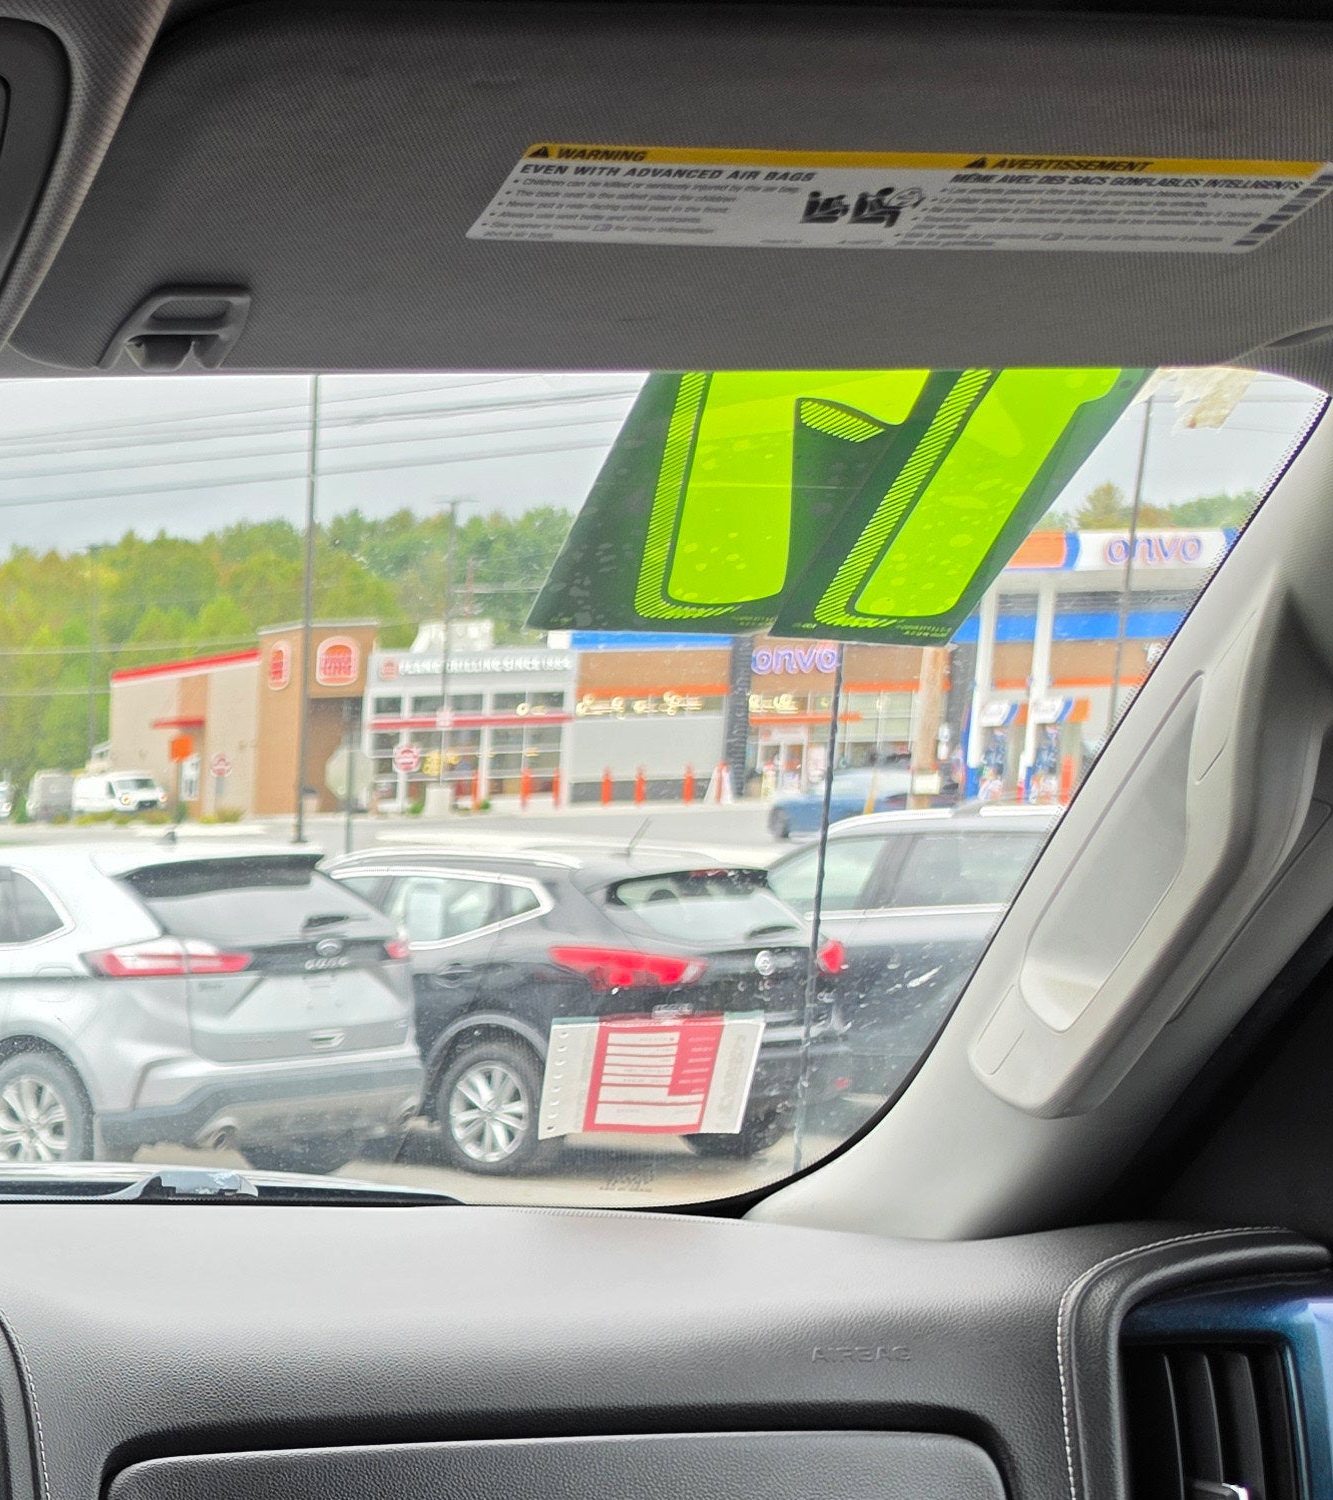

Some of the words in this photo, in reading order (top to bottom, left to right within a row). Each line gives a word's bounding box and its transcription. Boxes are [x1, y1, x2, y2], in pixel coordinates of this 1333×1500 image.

[557, 148, 647, 161] WARNING
[520, 164, 568, 174] EVEN
[573, 166, 621, 176] WITH
[623, 168, 723, 179] ADVANCED
[726, 170, 760, 180] AIR
[764, 172, 816, 181] BAGS
[991, 158, 1154, 172] AVERTISSEMENT
[1001, 175, 1035, 184] AVEC
[1038, 176, 1068, 185] DES
[1069, 176, 1107, 186] SACS
[1105, 535, 1203, 565] onvo
[751, 645, 838, 675] onvo
